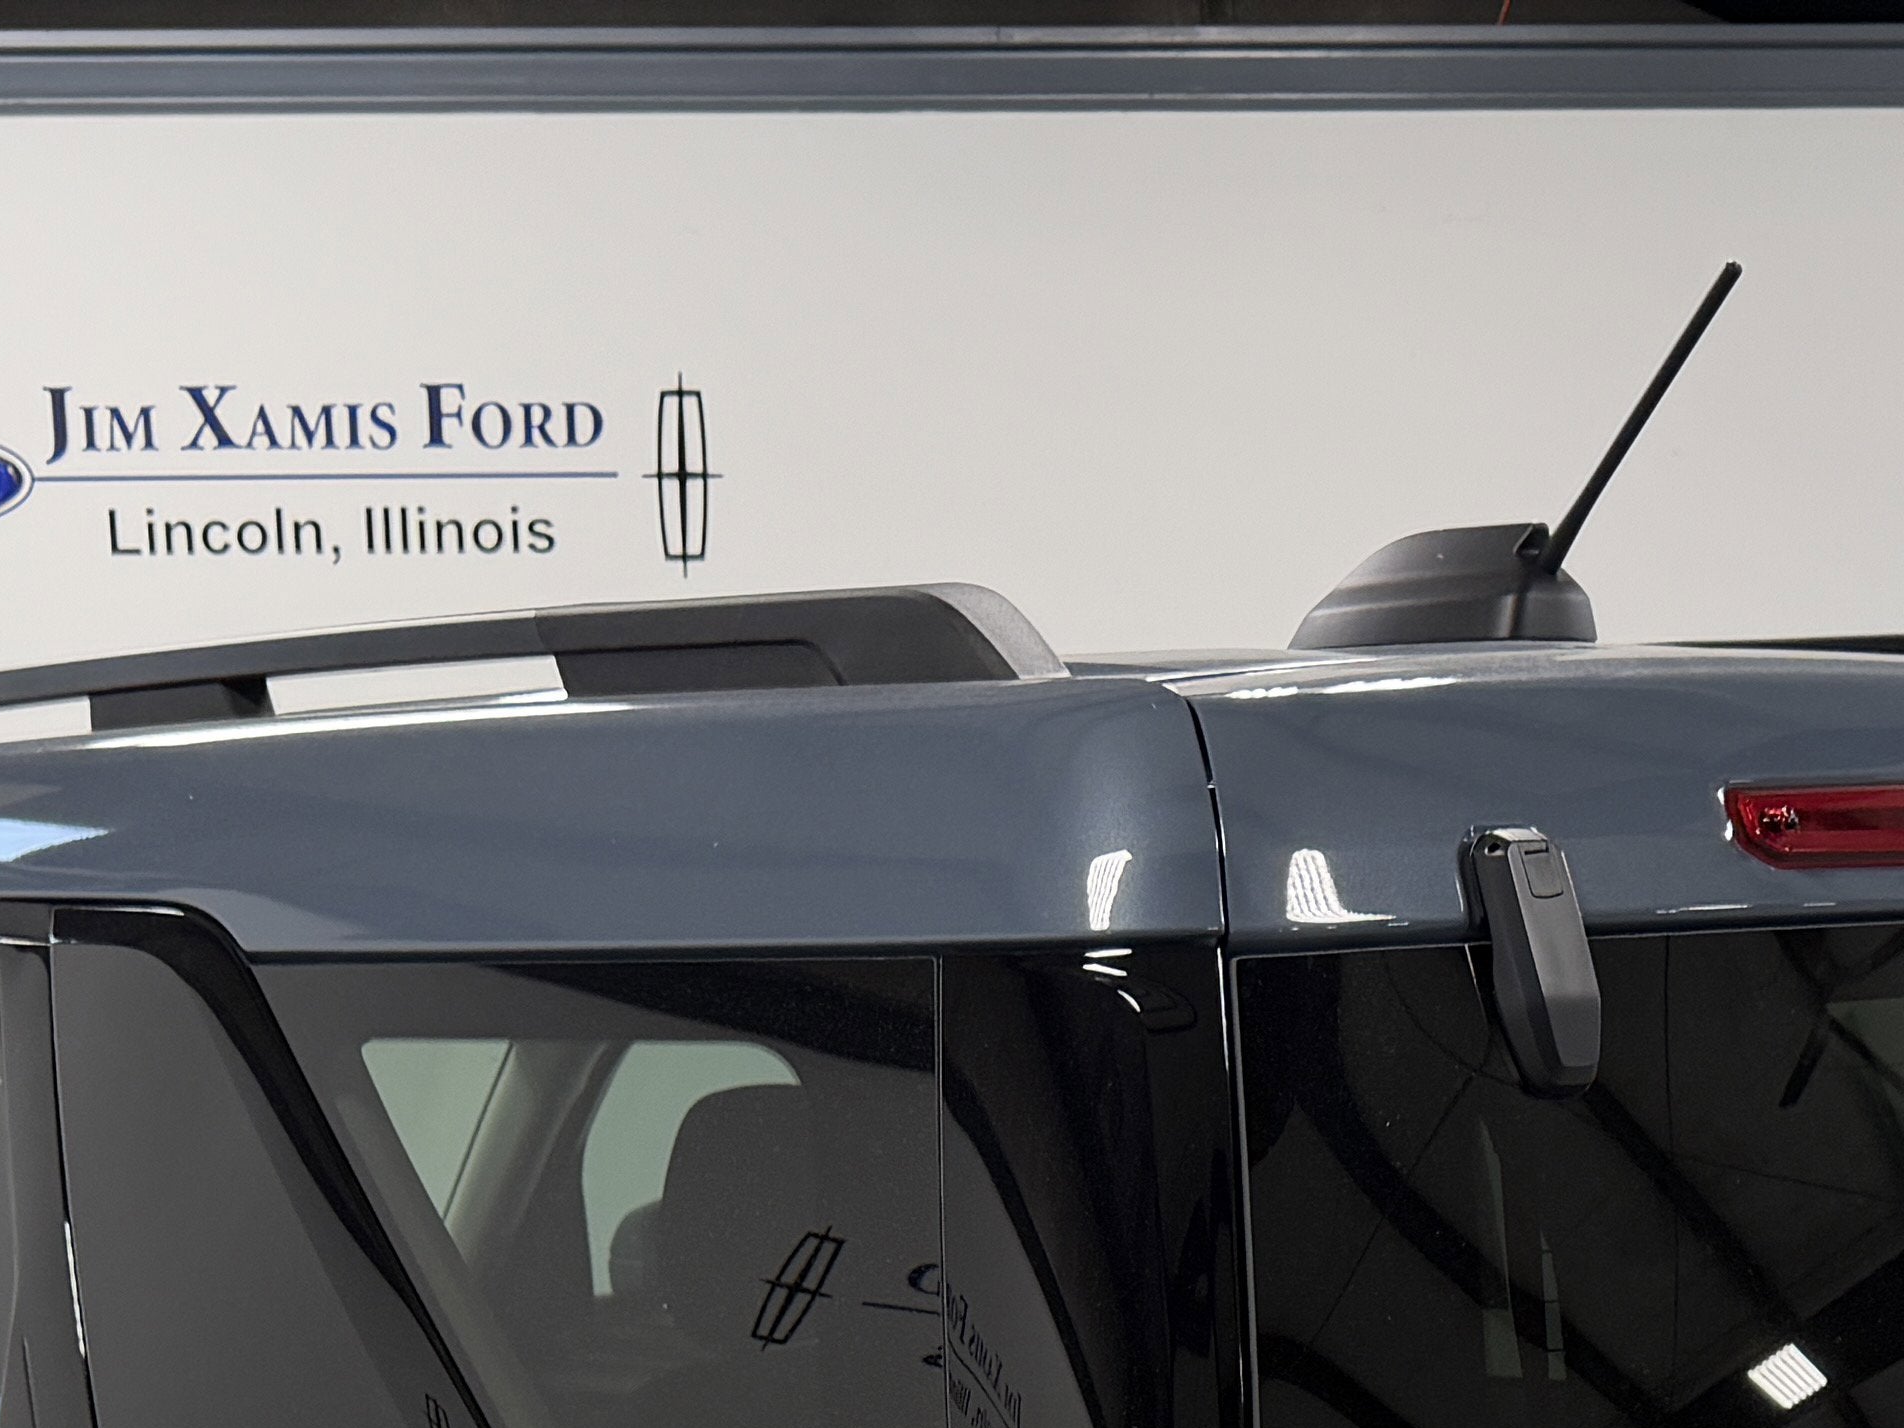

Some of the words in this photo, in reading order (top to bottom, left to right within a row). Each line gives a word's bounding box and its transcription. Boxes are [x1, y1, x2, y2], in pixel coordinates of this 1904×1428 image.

[42, 384, 160, 467] JIM
[178, 384, 399, 453] XAMIS
[418, 382, 605, 451] FORD
[107, 505, 342, 566] Lincoln,
[364, 504, 557, 556] Illinois
